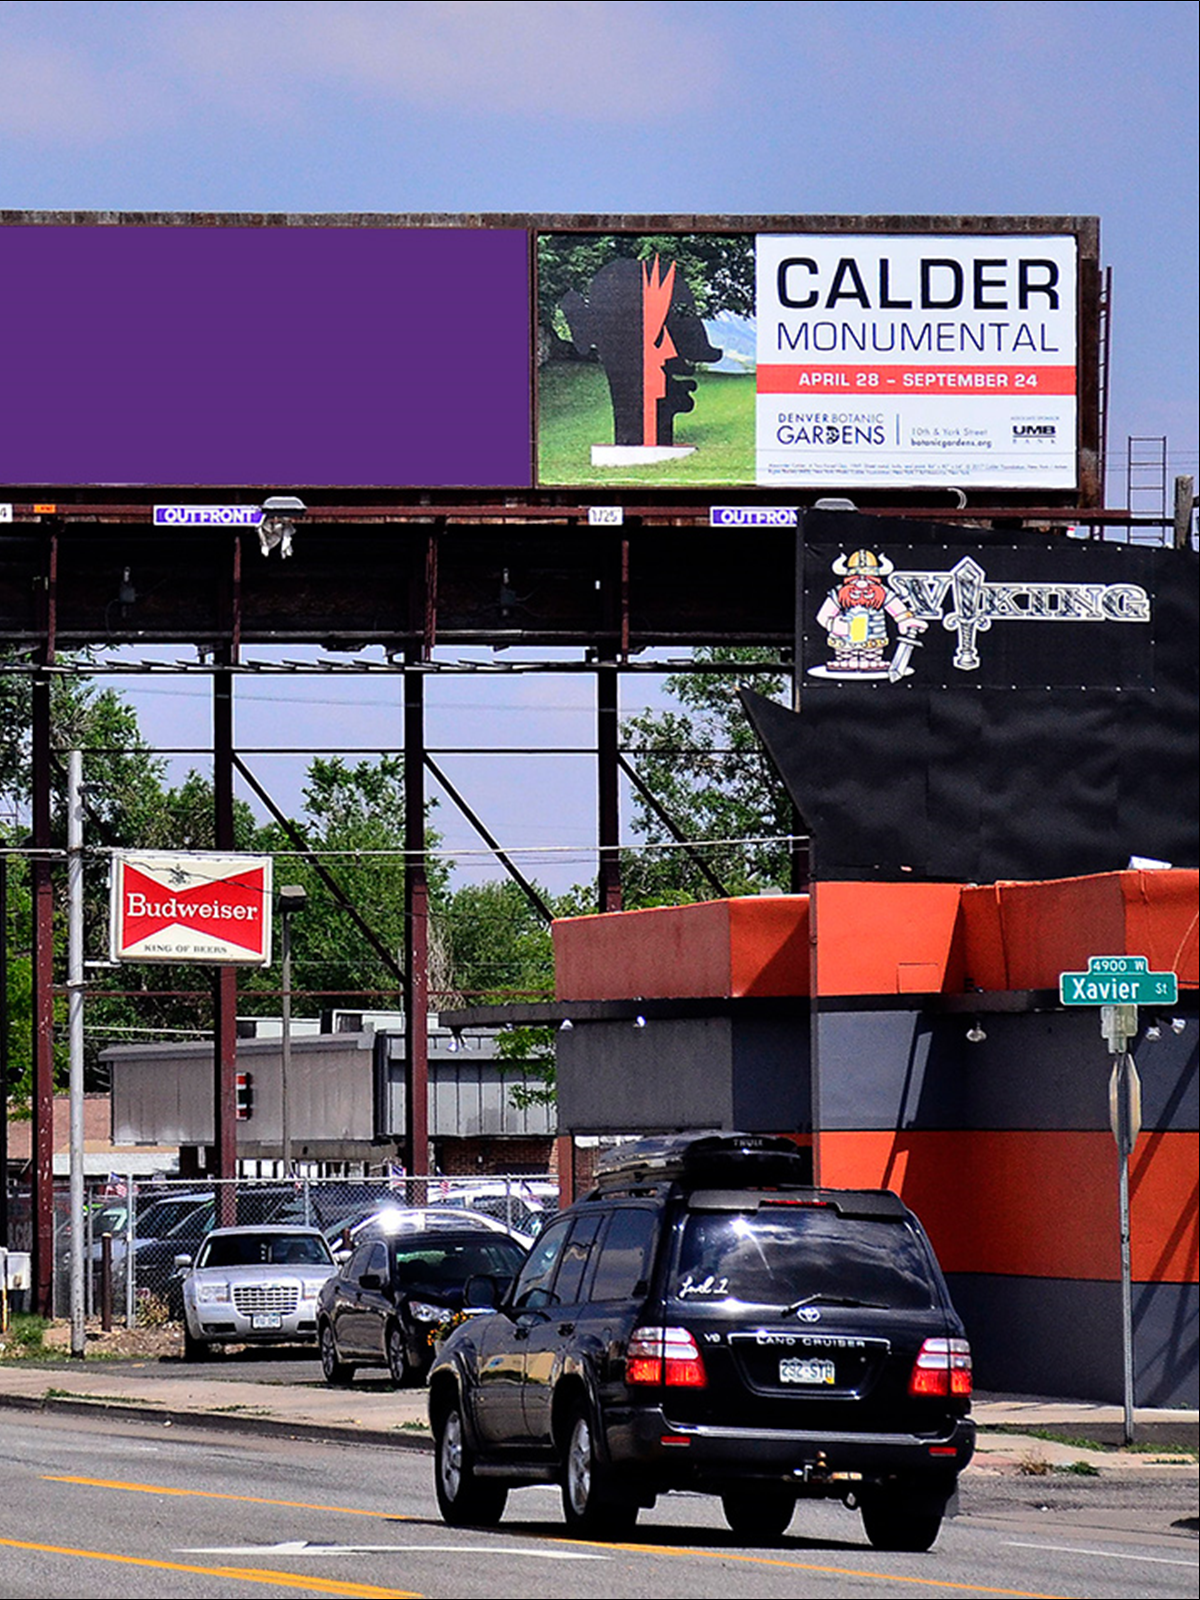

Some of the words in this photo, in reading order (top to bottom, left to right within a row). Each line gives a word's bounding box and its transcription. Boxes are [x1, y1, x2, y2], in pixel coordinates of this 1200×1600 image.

[777, 257, 1060, 310] CALDER
[777, 321, 1060, 352] MONUMENTAL
[798, 373, 850, 386] APRIL
[856, 374, 879, 386] 28
[903, 374, 1008, 387] SEPTEMBER
[1014, 375, 1038, 387] 24
[776, 425, 886, 445] GARDENS
[1012, 425, 1056, 435] UMB
[164, 509, 256, 523] OUTFRONT
[721, 510, 798, 524] OUTFRON
[126, 892, 259, 920] Budweiser
[1093, 960, 1127, 972] 4900
[1135, 961, 1145, 971] W
[1072, 978, 1140, 1000] Xavier
[1154, 982, 1168, 995] St
[756, 1335, 796, 1345] LAND
[802, 1337, 865, 1347] CRUISER
